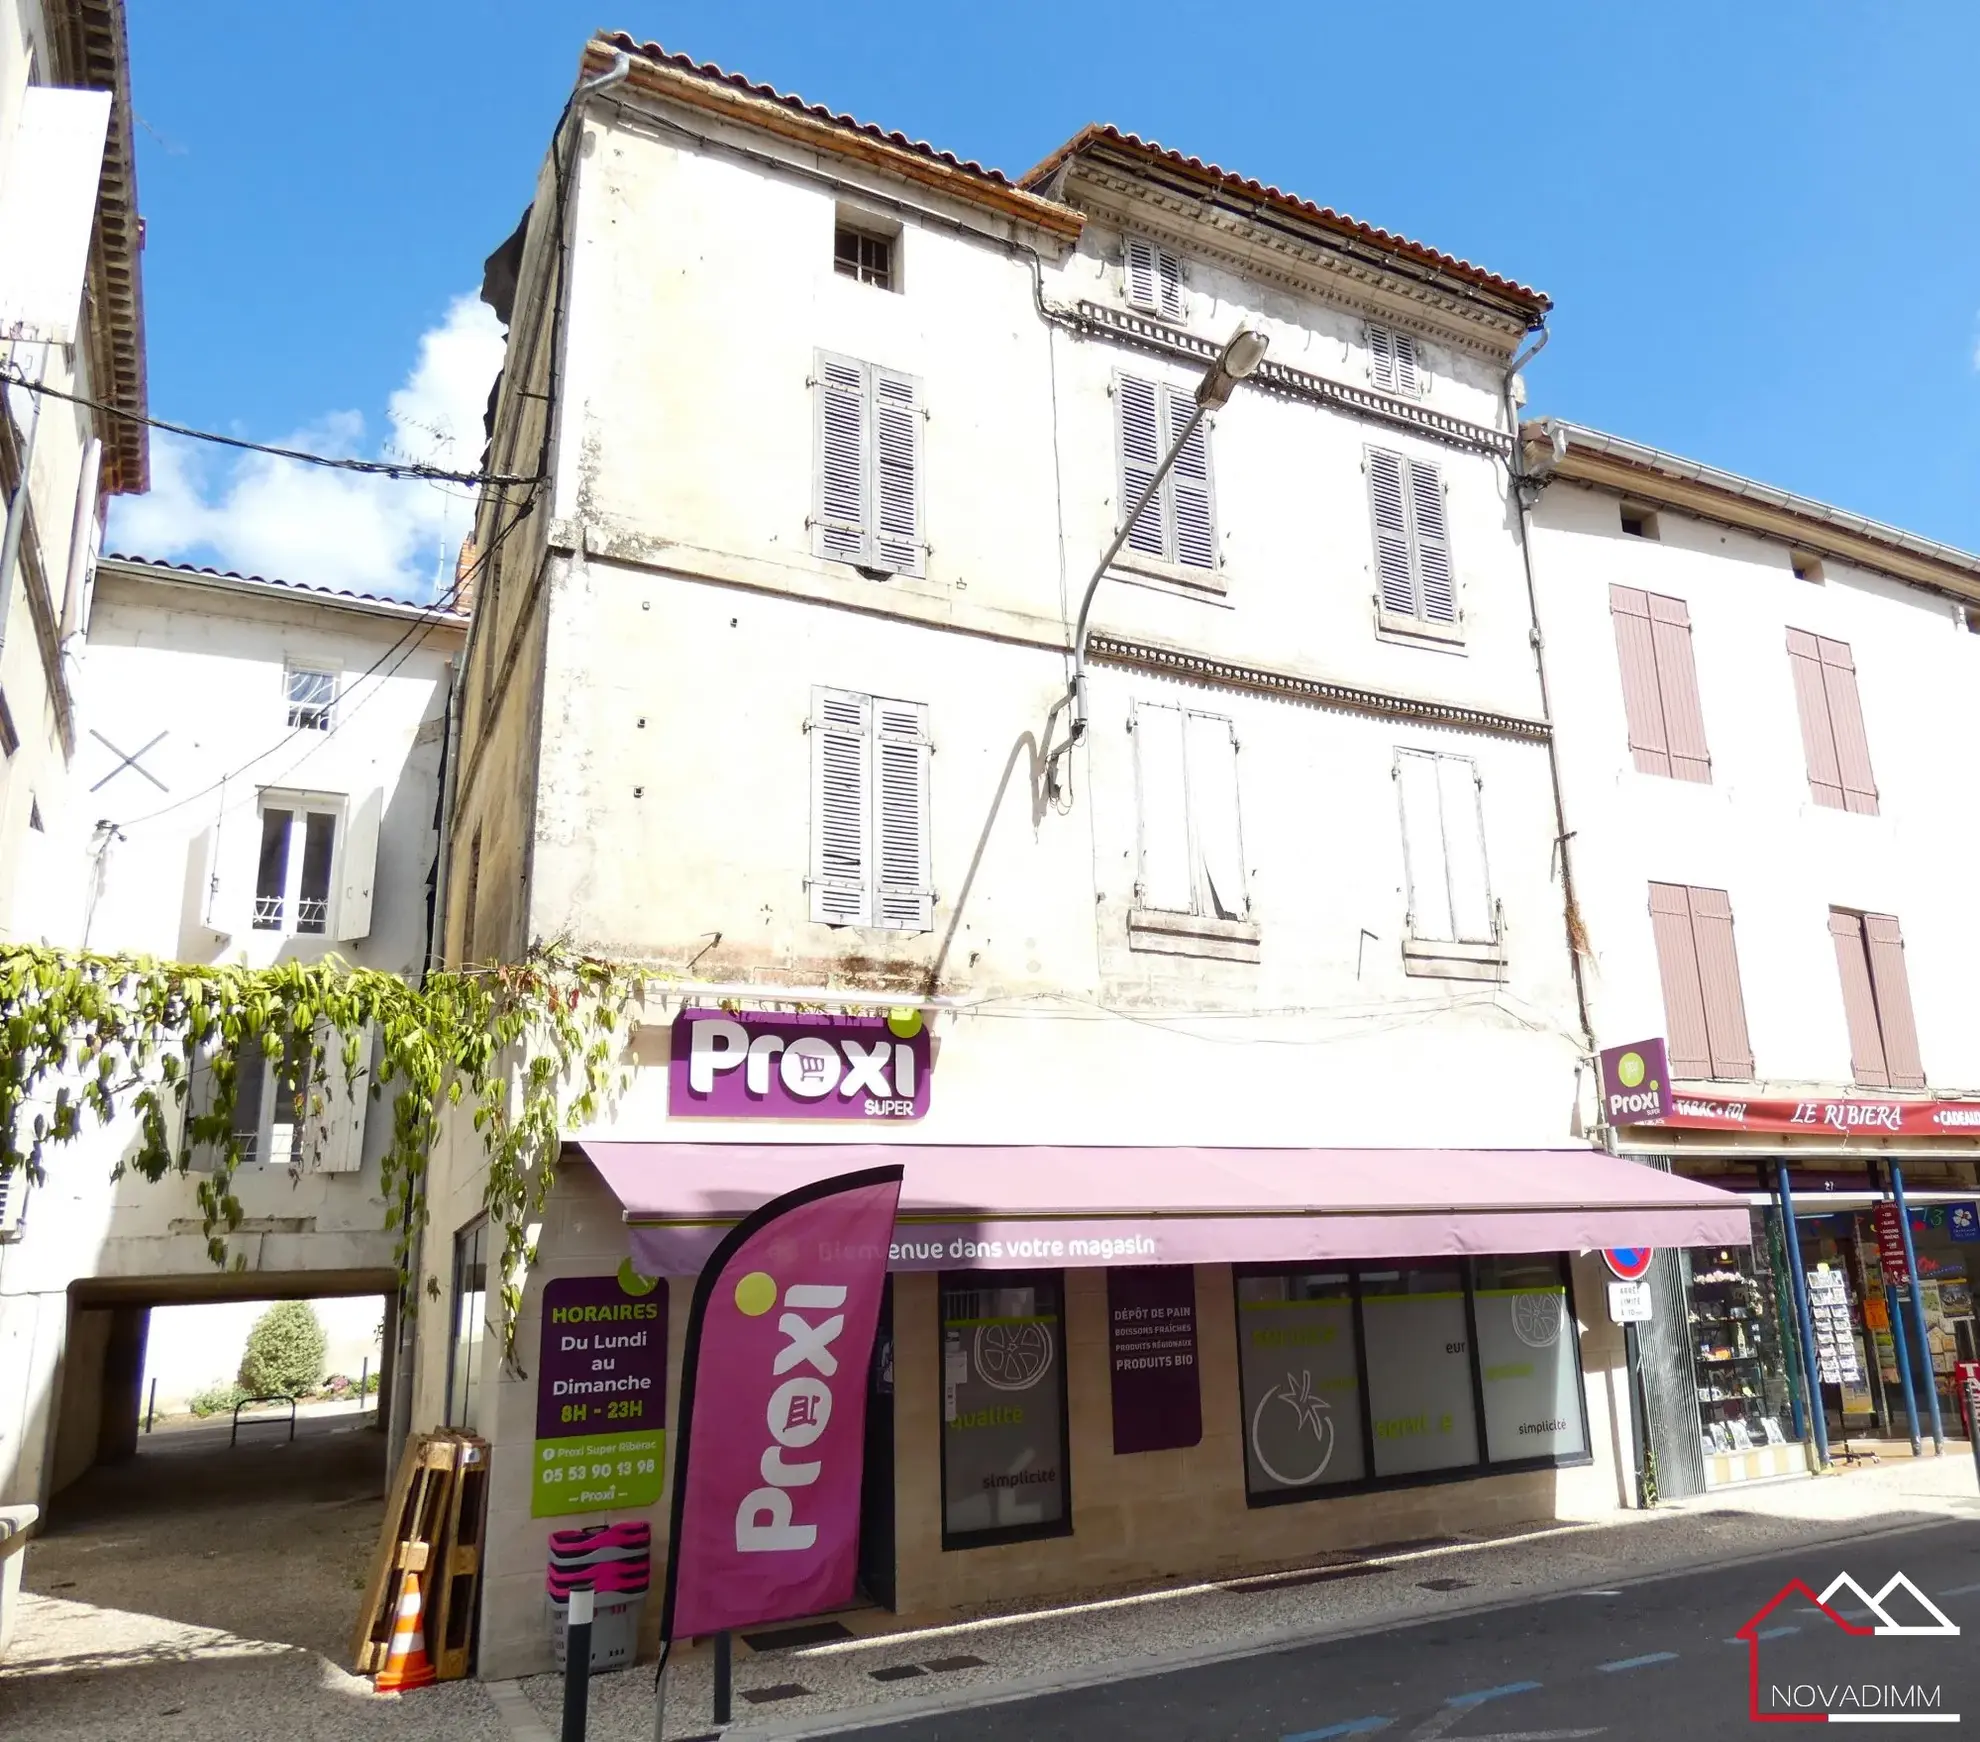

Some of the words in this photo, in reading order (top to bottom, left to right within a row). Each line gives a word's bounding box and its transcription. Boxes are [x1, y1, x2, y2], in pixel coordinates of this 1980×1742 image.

[689, 1010, 918, 1098] Proxi
[865, 1099, 914, 1117] SUPER
[1610, 1081, 1659, 1115] Proxi
[1676, 1099, 1717, 1117] TABAC
[1790, 1103, 1818, 1124] LE
[949, 1238, 1002, 1259] dans
[1005, 1239, 1064, 1258] votre
[1068, 1234, 1155, 1260] magasin
[552, 1303, 658, 1324] HORAIRES
[1115, 1306, 1148, 1321] DÉPÔT
[1151, 1307, 1164, 1318] DE
[1166, 1306, 1191, 1318] PAIN
[1115, 1325, 1153, 1336] BOISSONS
[1155, 1321, 1191, 1334] FRAÎCHES
[561, 1336, 588, 1351] Du
[594, 1330, 648, 1349] Lundi
[1115, 1342, 1151, 1351] PRODUITS
[591, 1358, 615, 1371] au
[1116, 1356, 1172, 1371] PRODUITS
[1175, 1354, 1193, 1366] BIO
[553, 1375, 652, 1396] Dimanche
[561, 1404, 587, 1423] 8H
[607, 1400, 643, 1419] 23H
[735, 1272, 848, 1552] Proxi
[1518, 1418, 1567, 1435] simplicité
[558, 1447, 584, 1458] Proxi
[587, 1443, 616, 1456] Super
[543, 1468, 563, 1483] 05
[568, 1465, 586, 1480] 53
[592, 1463, 612, 1479] 90
[983, 1467, 1056, 1490] simplicité
[581, 1484, 616, 1503] Proxi
